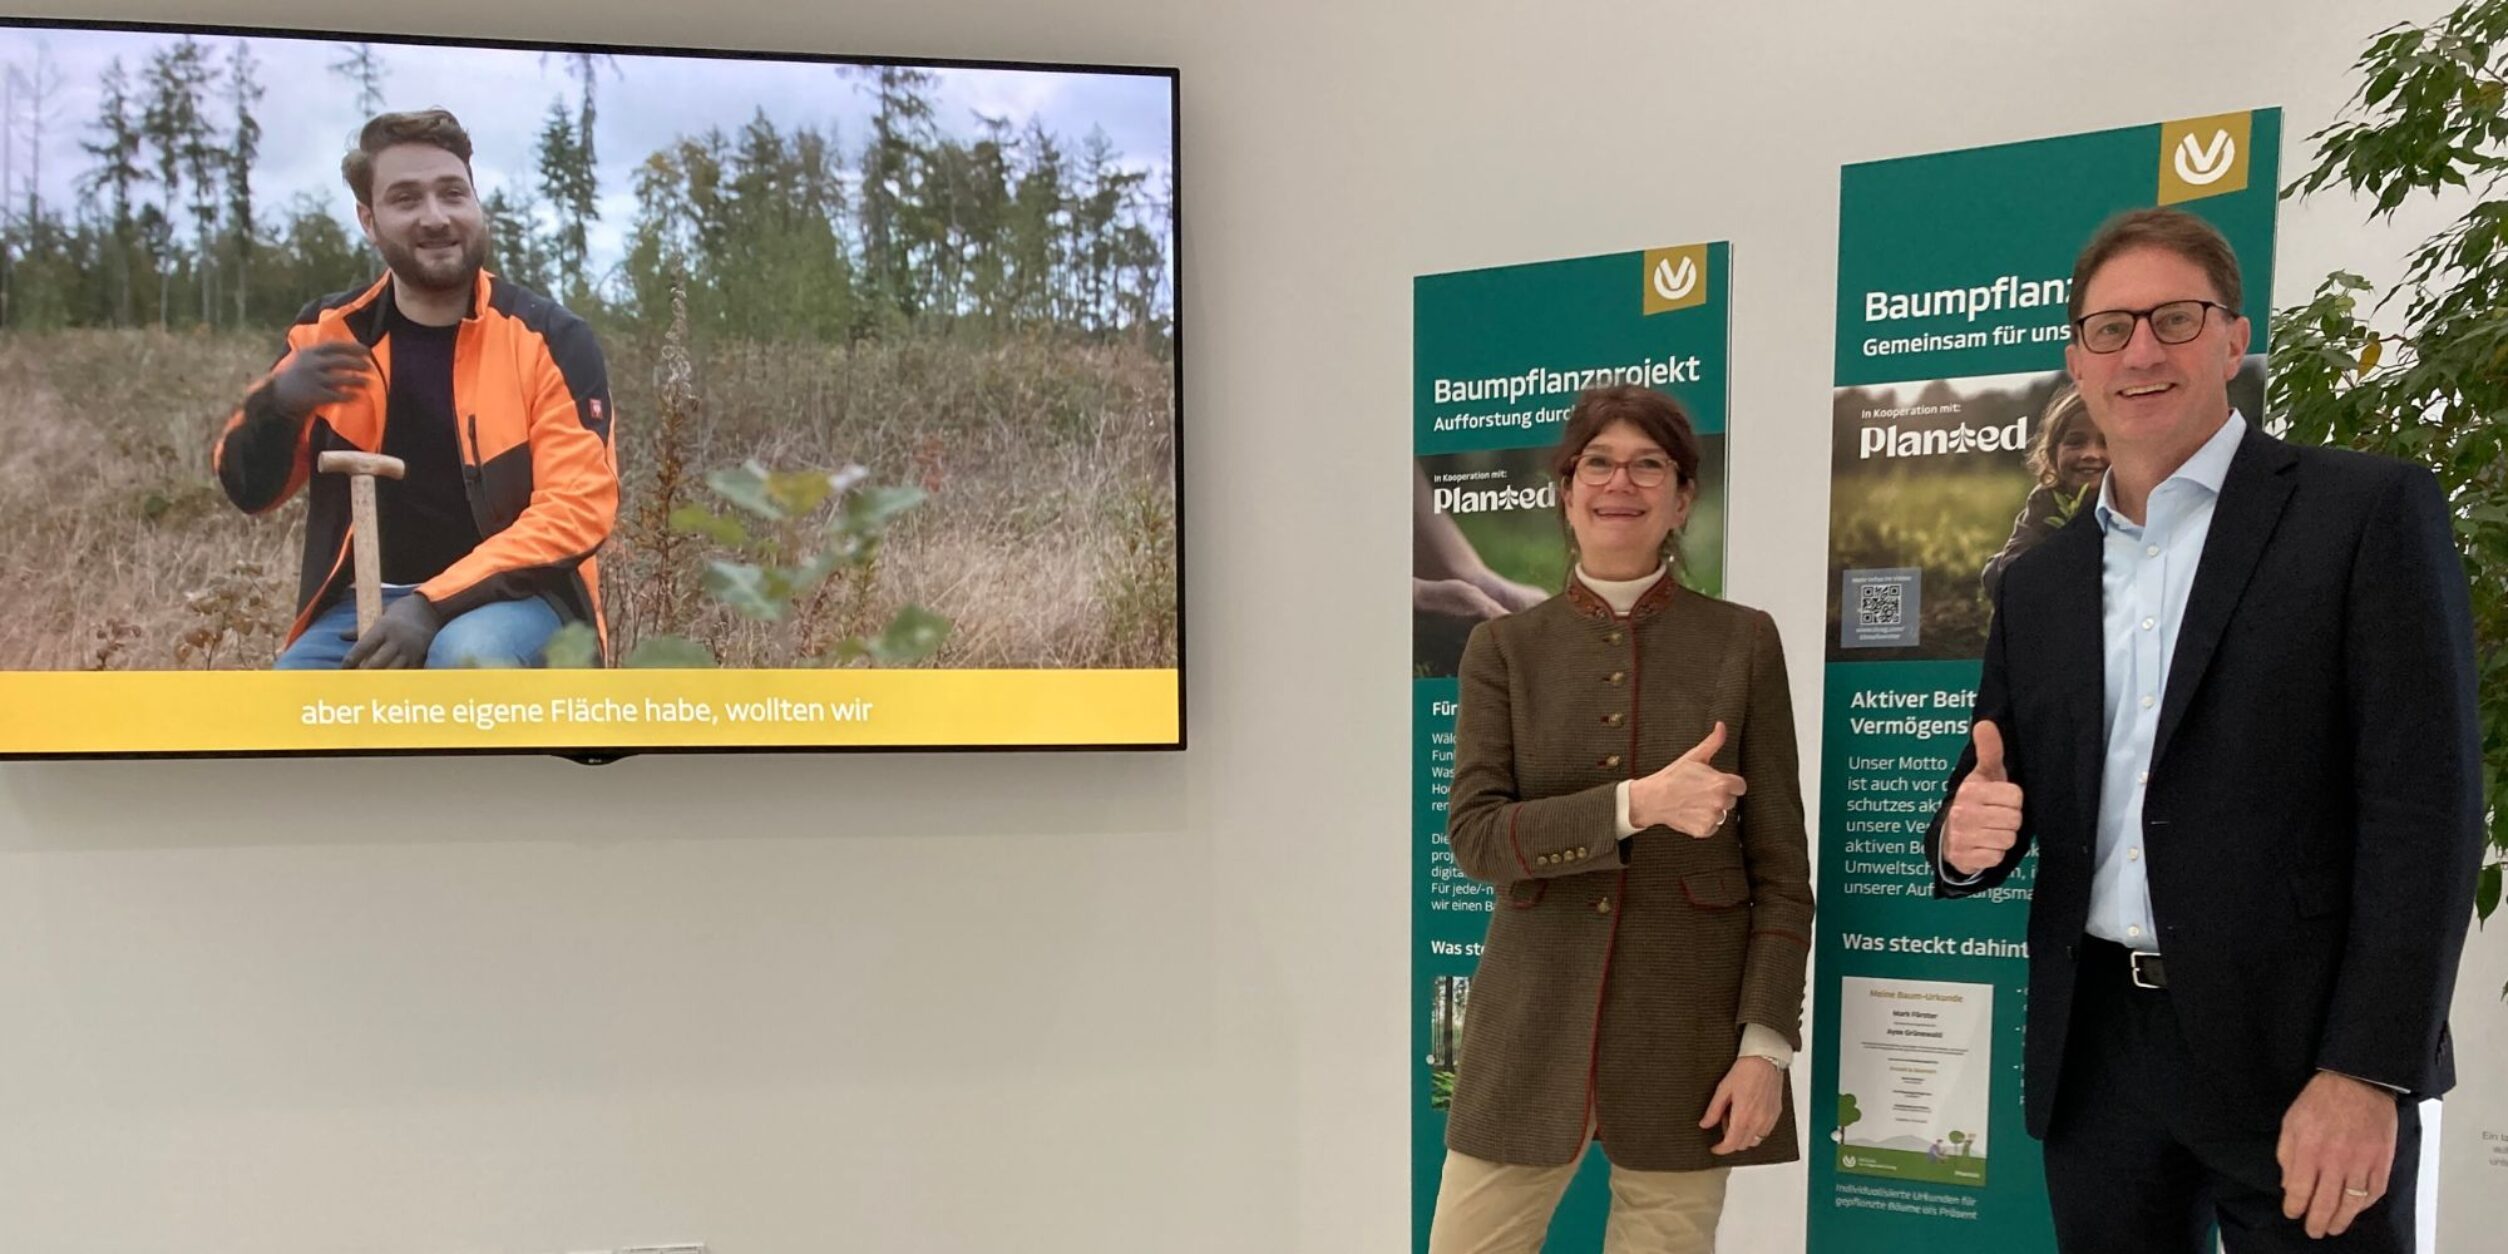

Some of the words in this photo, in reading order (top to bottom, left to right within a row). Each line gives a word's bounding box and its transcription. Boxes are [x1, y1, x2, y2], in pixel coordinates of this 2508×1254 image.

[1863, 331, 1987, 357] Gemeinsam
[1993, 326, 2026, 345] für
[2031, 324, 2071, 342] uns
[1434, 355, 1701, 405] Baumpflanzprojekt
[1861, 409, 1872, 419] In
[1873, 405, 1937, 419] Kooperation
[1940, 403, 1961, 413] mit:
[1433, 411, 1532, 432] Aufforstung
[1860, 416, 2028, 459] Planted
[1434, 474, 1441, 483] In
[1443, 472, 1490, 483] Kooperation
[1491, 470, 1507, 479] mit:
[1434, 481, 1556, 514] Planted
[1850, 690, 1929, 708] Aktiver
[1933, 689, 1978, 708] Beit
[301, 699, 363, 725] aber
[372, 698, 445, 724] keine
[452, 698, 543, 730] eigene
[551, 698, 637, 723] Fläche
[645, 697, 718, 726] habe,
[725, 697, 824, 722] wollten
[831, 697, 872, 722] wir
[1432, 701, 1458, 716] Für
[1850, 716, 1969, 739] Vermögens
[1432, 750, 1456, 761] Fun
[1849, 756, 1895, 770] Unser
[1899, 756, 1948, 771] Motto
[1847, 776, 1867, 790] ist
[1871, 777, 1908, 791] auch
[1911, 780, 1938, 791] vor
[1847, 797, 1916, 812] schutzes
[1846, 820, 1901, 833] unsere
[1845, 839, 1905, 854] aktiven
[1431, 882, 1449, 894] Für
[1844, 882, 1903, 896] unserer
[1431, 900, 1449, 910] wir
[1451, 900, 1482, 911] einen
[1431, 941, 1462, 955] Was
[1843, 933, 1884, 951] Was
[1889, 936, 1956, 955] steckt
[1960, 938, 2030, 958] dahint
